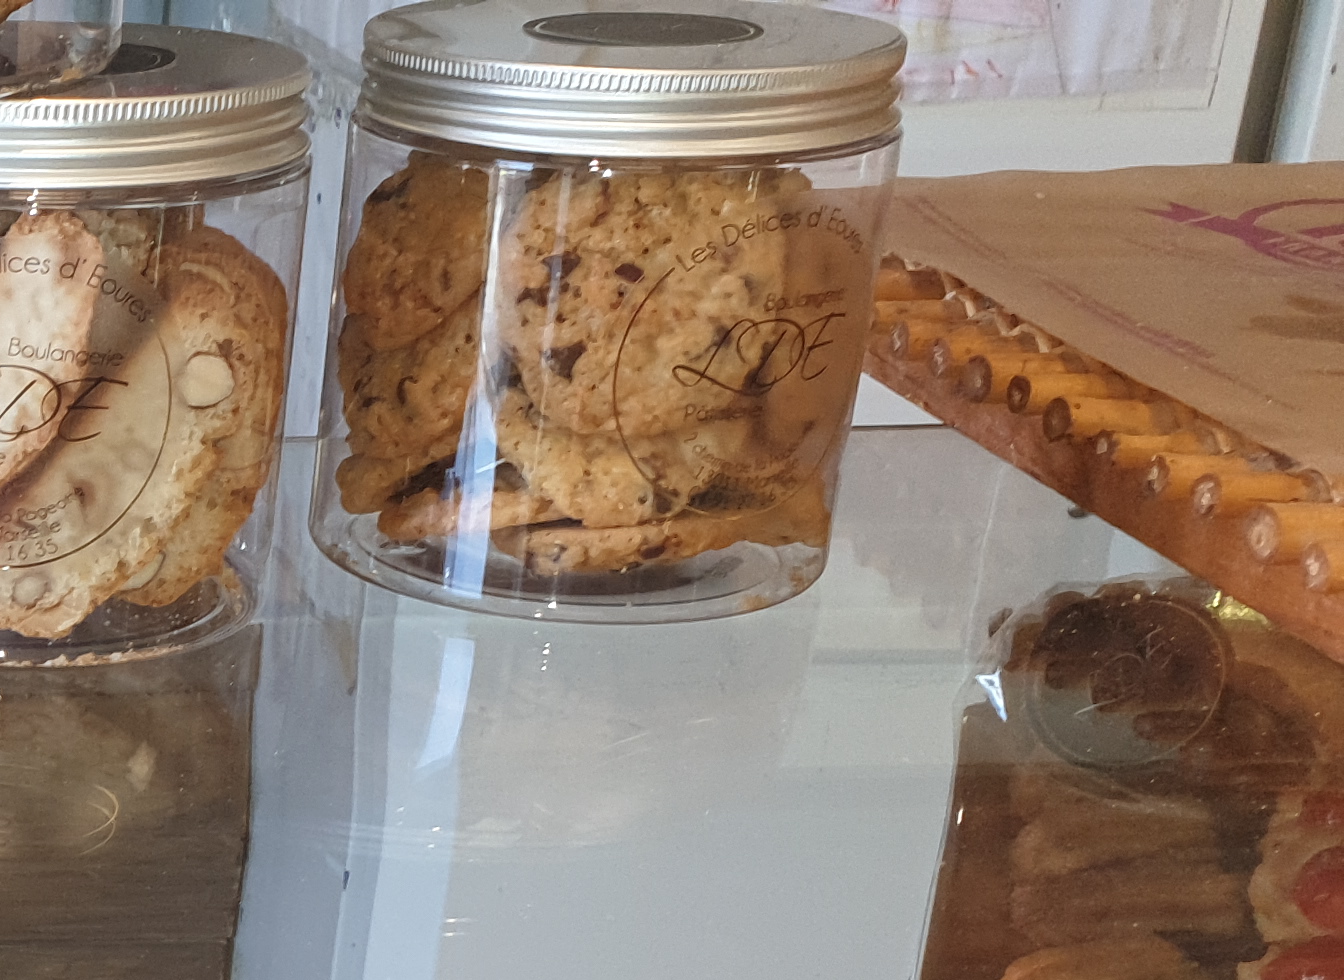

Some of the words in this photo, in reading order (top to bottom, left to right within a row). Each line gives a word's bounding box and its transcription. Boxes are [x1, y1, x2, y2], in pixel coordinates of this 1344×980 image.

[675, 241, 717, 273] Les
[721, 211, 802, 247] Délices
[86, 263, 153, 324] Eoures
[7, 337, 124, 367] Boulangerie
[6, 544, 29, 562] 16
[34, 538, 60, 558] 35
